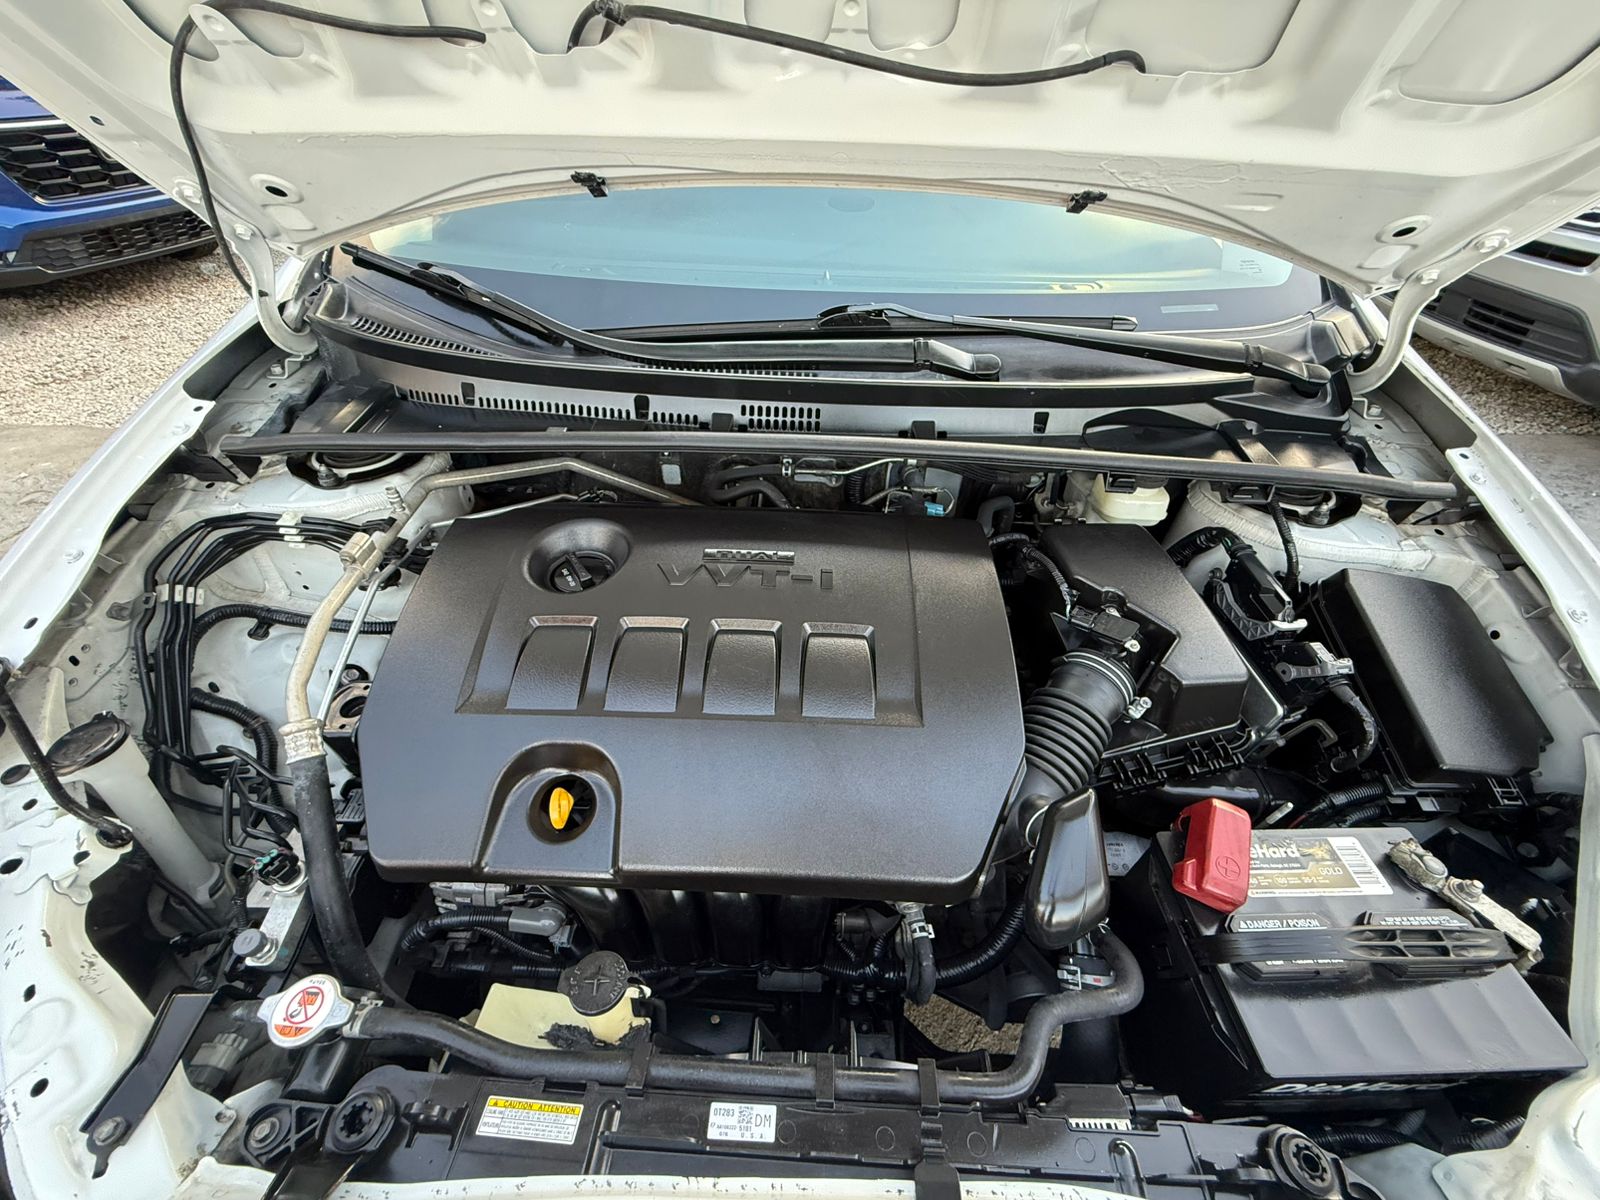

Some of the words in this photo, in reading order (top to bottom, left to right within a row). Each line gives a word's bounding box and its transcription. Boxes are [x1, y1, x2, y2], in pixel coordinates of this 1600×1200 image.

[1249, 843, 1300, 858] eHard
[1320, 866, 1344, 876] GOLD
[1245, 919, 1282, 928] DANGER
[1287, 918, 1320, 928] POISON
[503, 1100, 533, 1109] CAUTION
[538, 1103, 576, 1114] ATTENTION
[754, 1113, 772, 1129] DM
